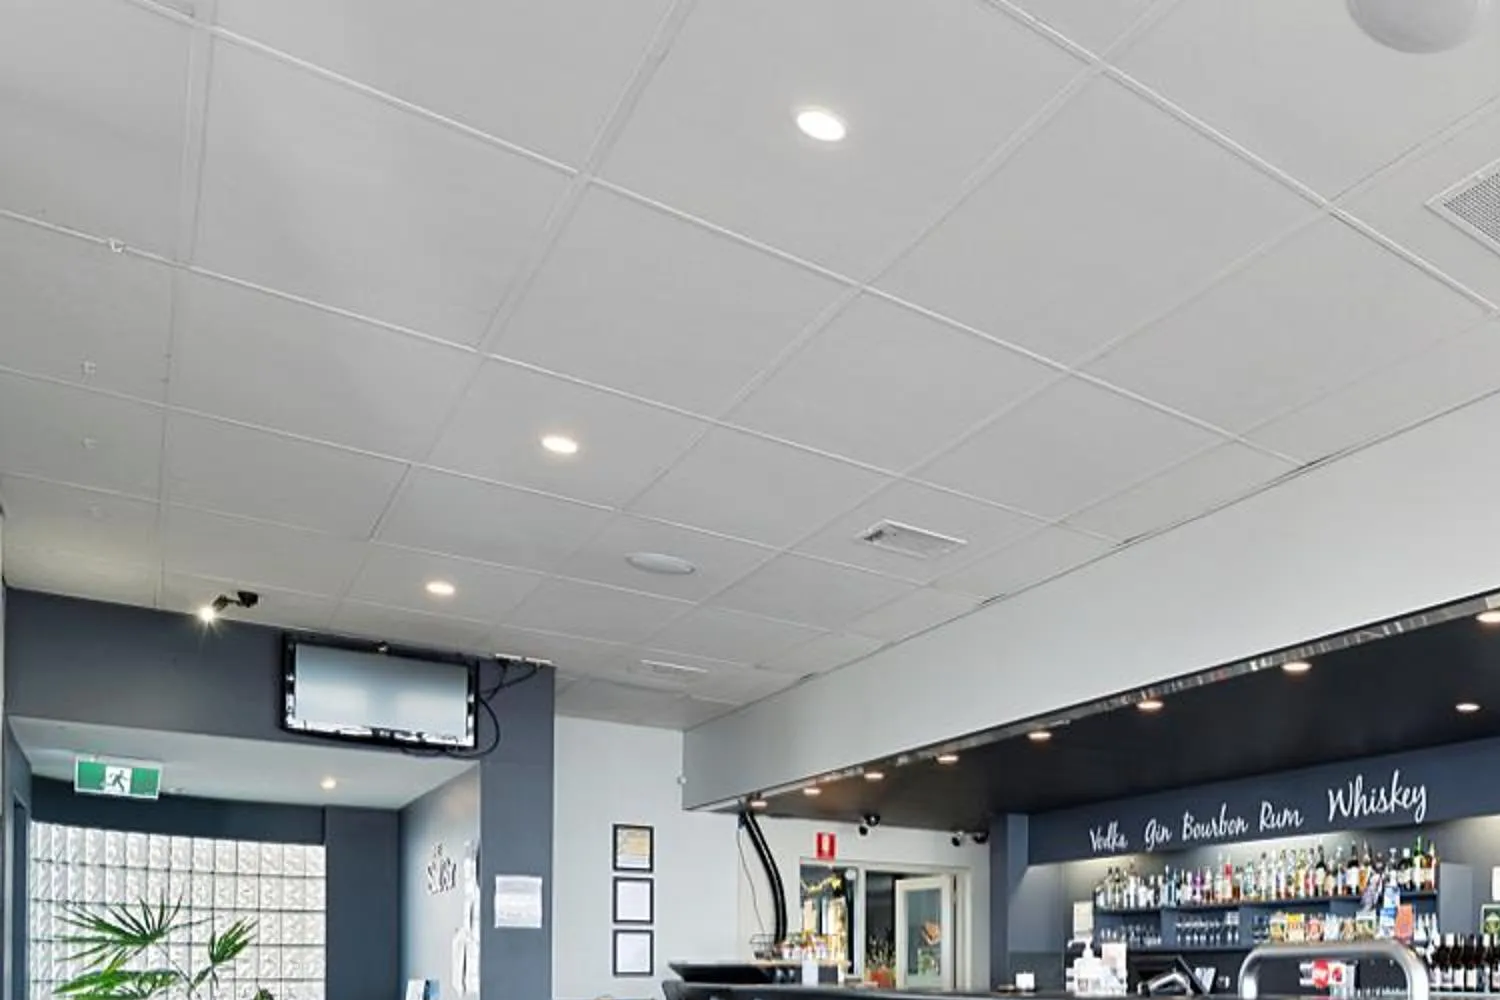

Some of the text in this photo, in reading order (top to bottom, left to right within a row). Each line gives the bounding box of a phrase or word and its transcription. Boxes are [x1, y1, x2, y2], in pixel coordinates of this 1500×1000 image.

[1089, 769, 1427, 852] Vodka Gin Bourbon Rum Whiskey
